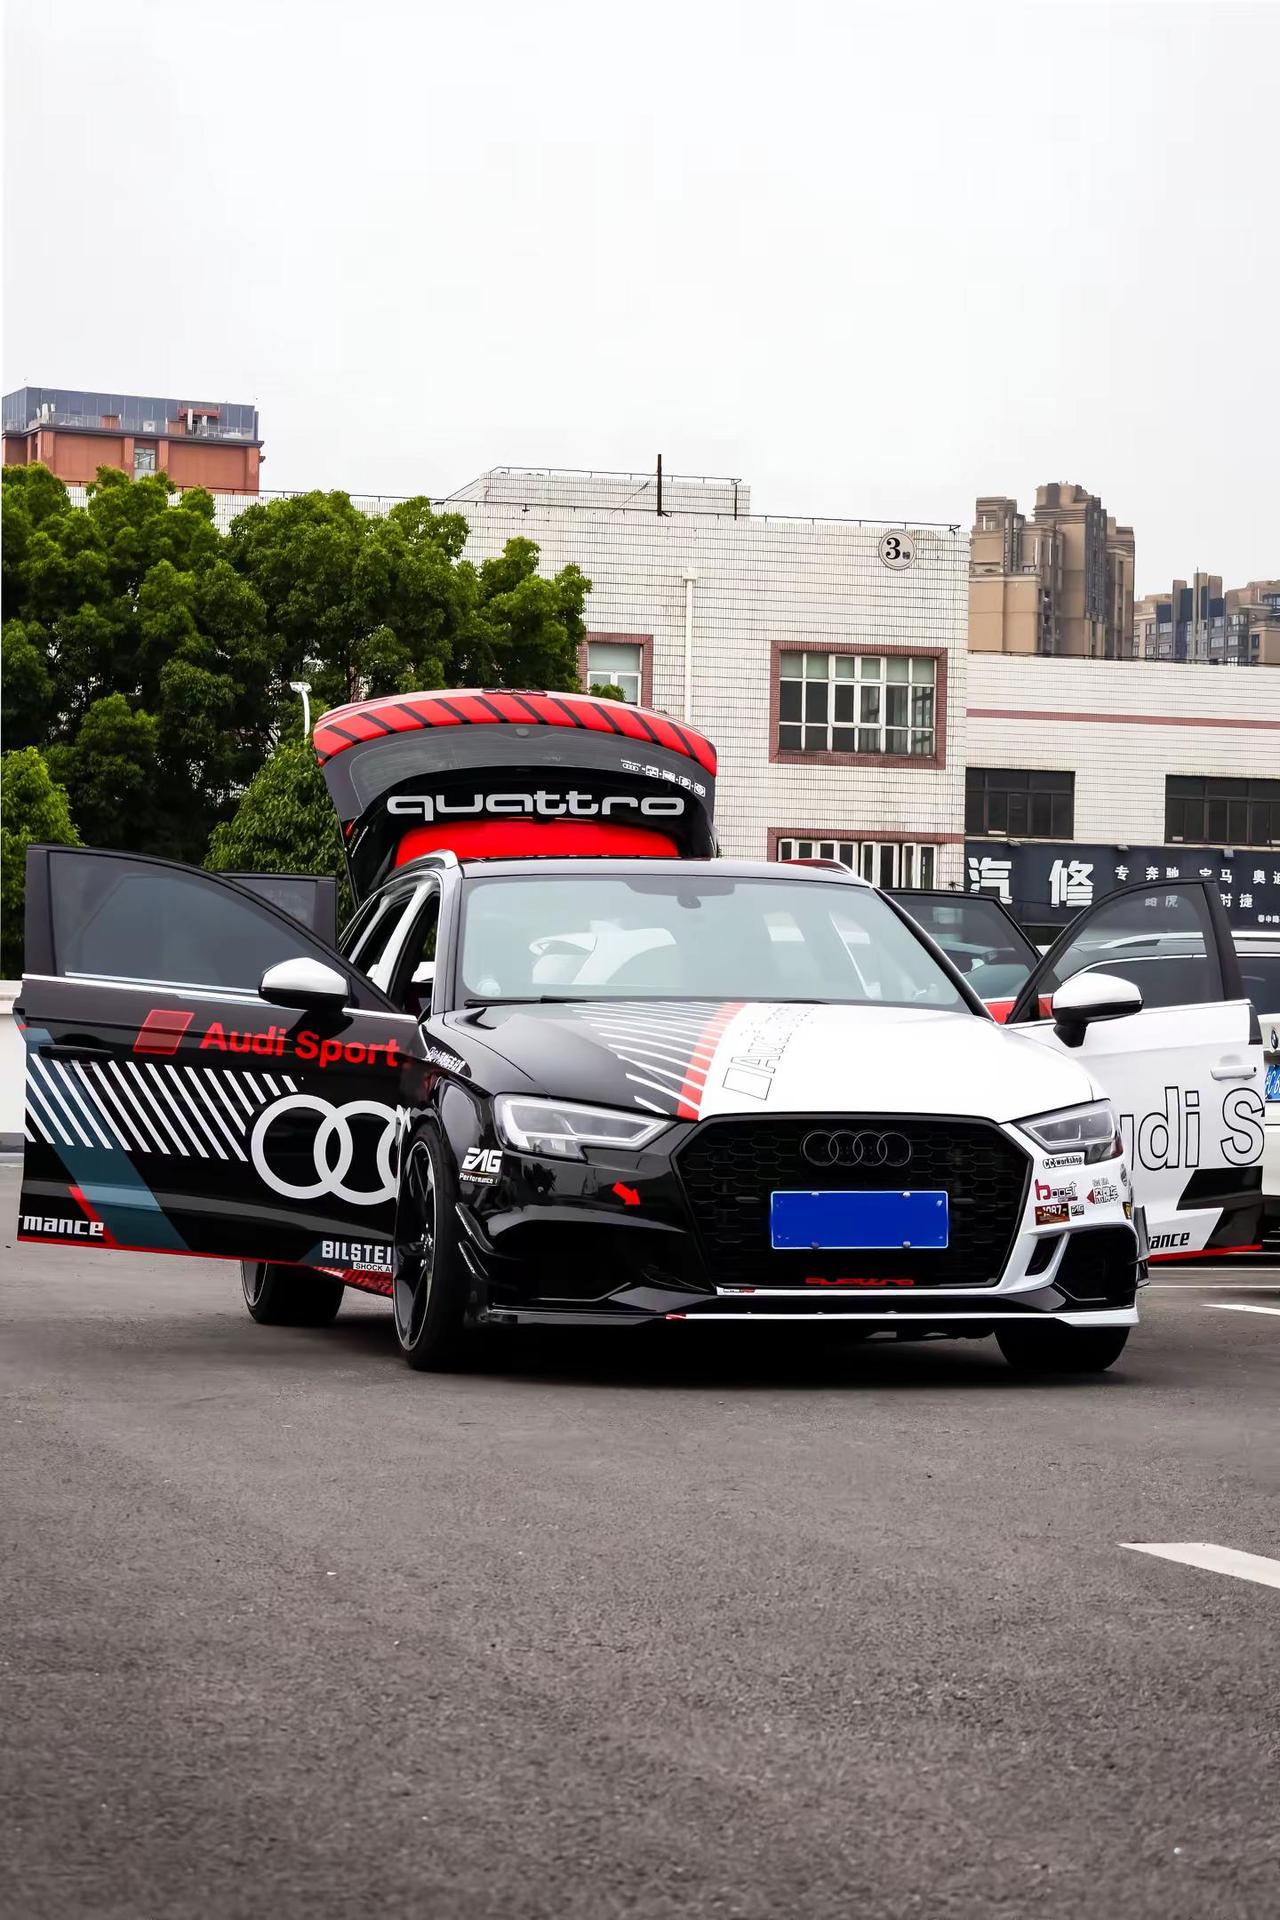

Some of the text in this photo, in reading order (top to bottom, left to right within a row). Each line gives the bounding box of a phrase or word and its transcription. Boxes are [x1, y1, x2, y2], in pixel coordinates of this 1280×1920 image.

[886, 537, 901, 560] 3
[387, 790, 685, 821] quattro
[968, 857, 1094, 908] 汽修
[1114, 865, 1130, 881] 专
[200, 1022, 287, 1056] Audi
[294, 1030, 401, 1068] Sport
[1149, 1232, 1191, 1249] ance
[355, 1262, 383, 1272] SHOCK
